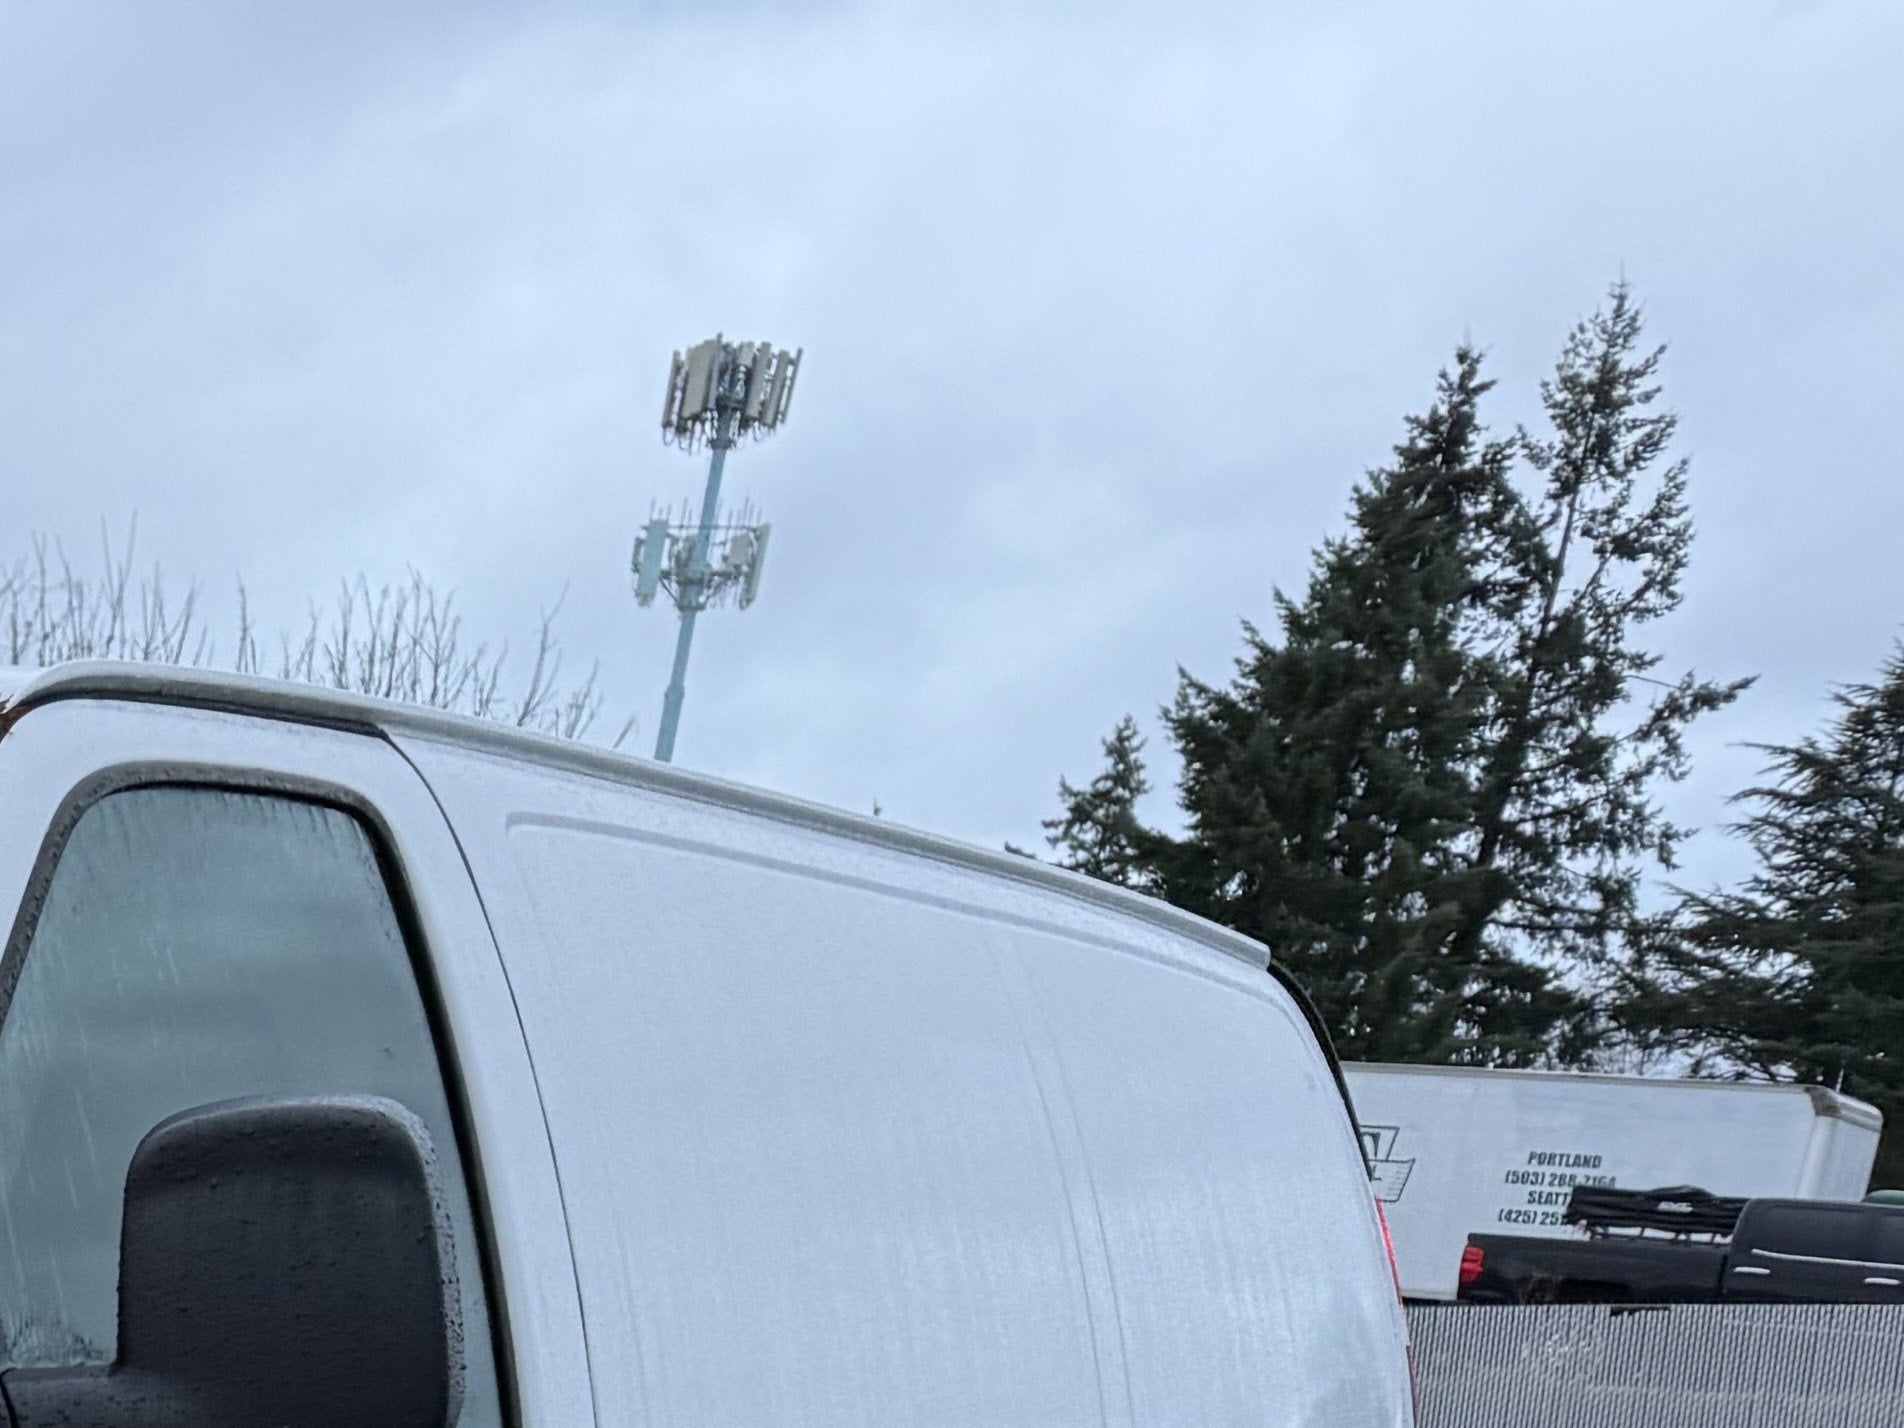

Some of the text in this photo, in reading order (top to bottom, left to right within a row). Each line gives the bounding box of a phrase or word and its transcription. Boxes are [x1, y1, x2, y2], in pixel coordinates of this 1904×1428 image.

[1527, 1151, 1603, 1169] PORTLAND
[1505, 1170, 1546, 1187] (503)
[1527, 1190, 1571, 1206] SEATT
